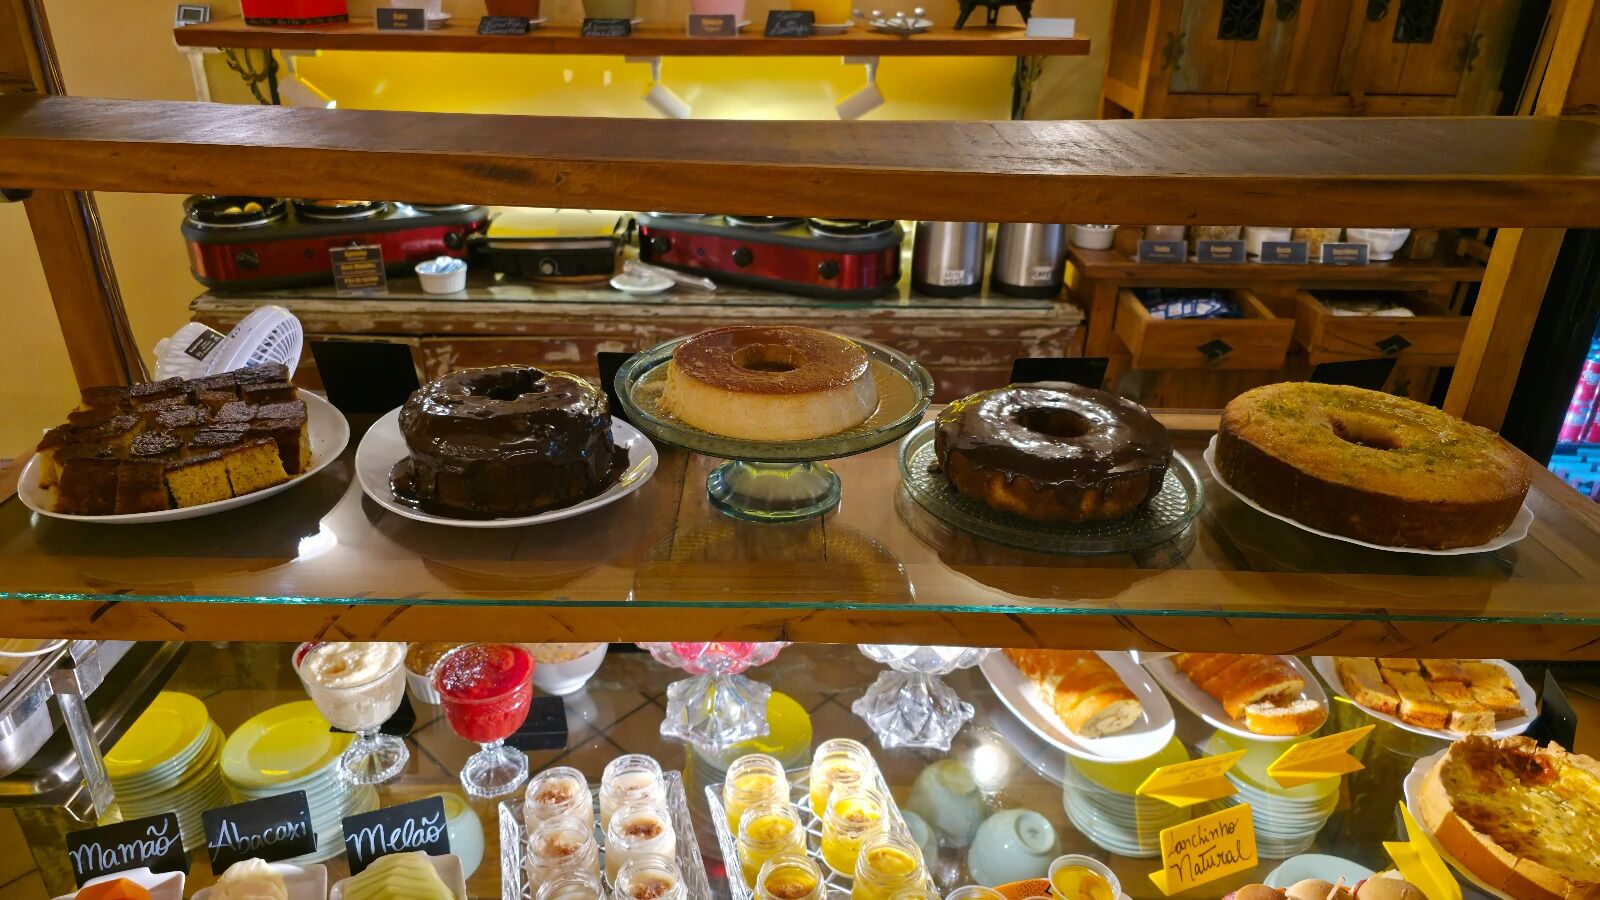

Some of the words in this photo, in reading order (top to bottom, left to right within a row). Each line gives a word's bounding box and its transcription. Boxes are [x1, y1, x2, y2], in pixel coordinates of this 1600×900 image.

[69, 818, 181, 873] Mamão
[208, 811, 306, 861] Abacaxi
[345, 811, 447, 857] Melão
[1168, 817, 1239, 857] Lanchinho
[1171, 840, 1252, 882] Natural
